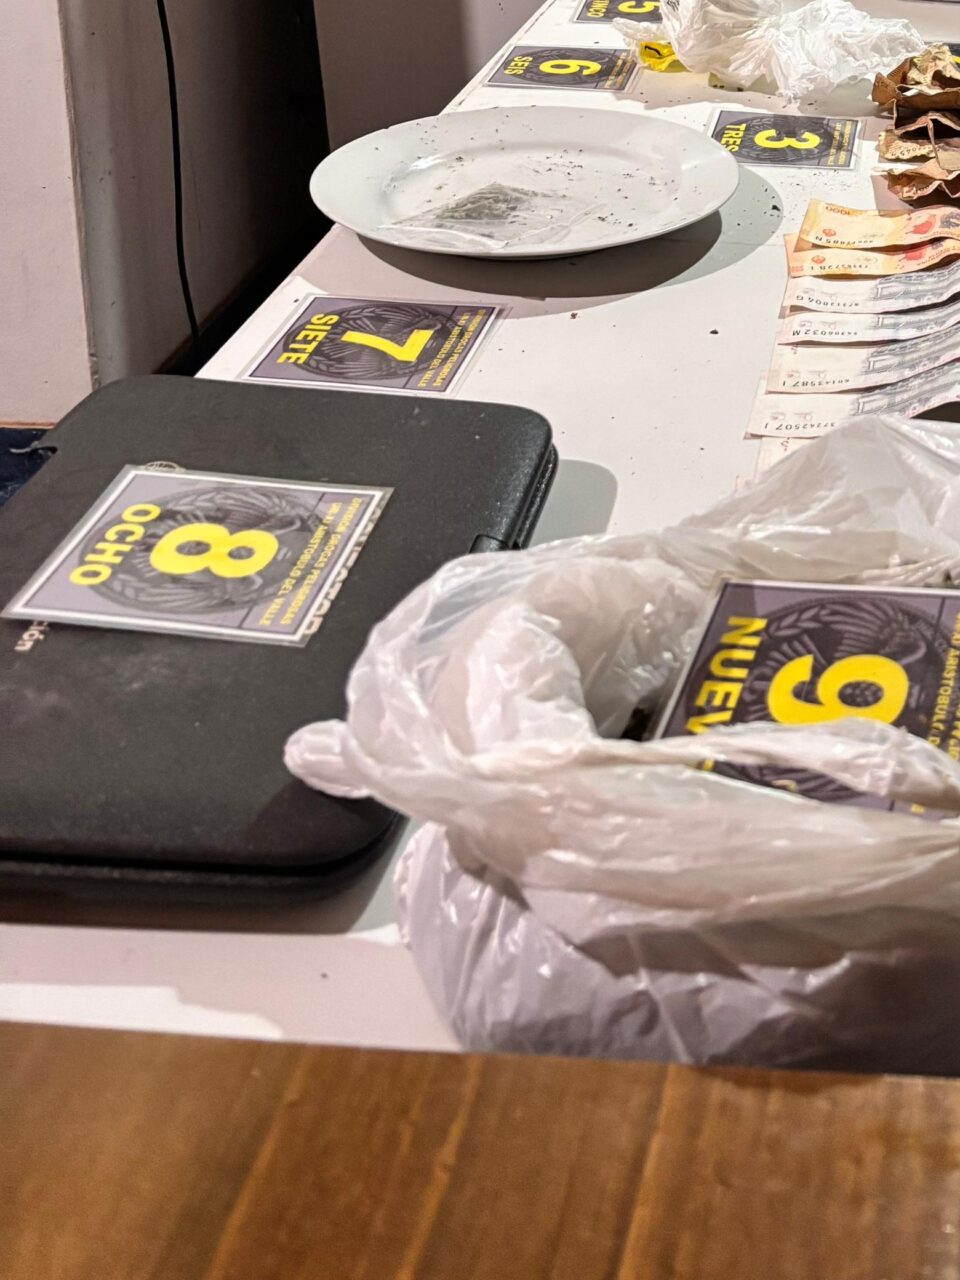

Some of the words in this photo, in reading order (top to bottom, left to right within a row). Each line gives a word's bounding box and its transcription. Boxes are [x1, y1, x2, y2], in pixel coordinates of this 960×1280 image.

[502, 55, 524, 76] SEIS
[754, 128, 821, 151] 3
[276, 313, 340, 365] SIETE
[340, 328, 433, 364] 7
[68, 503, 162, 586] OCHO
[149, 522, 279, 579] 8
[686, 615, 768, 738] NUEV
